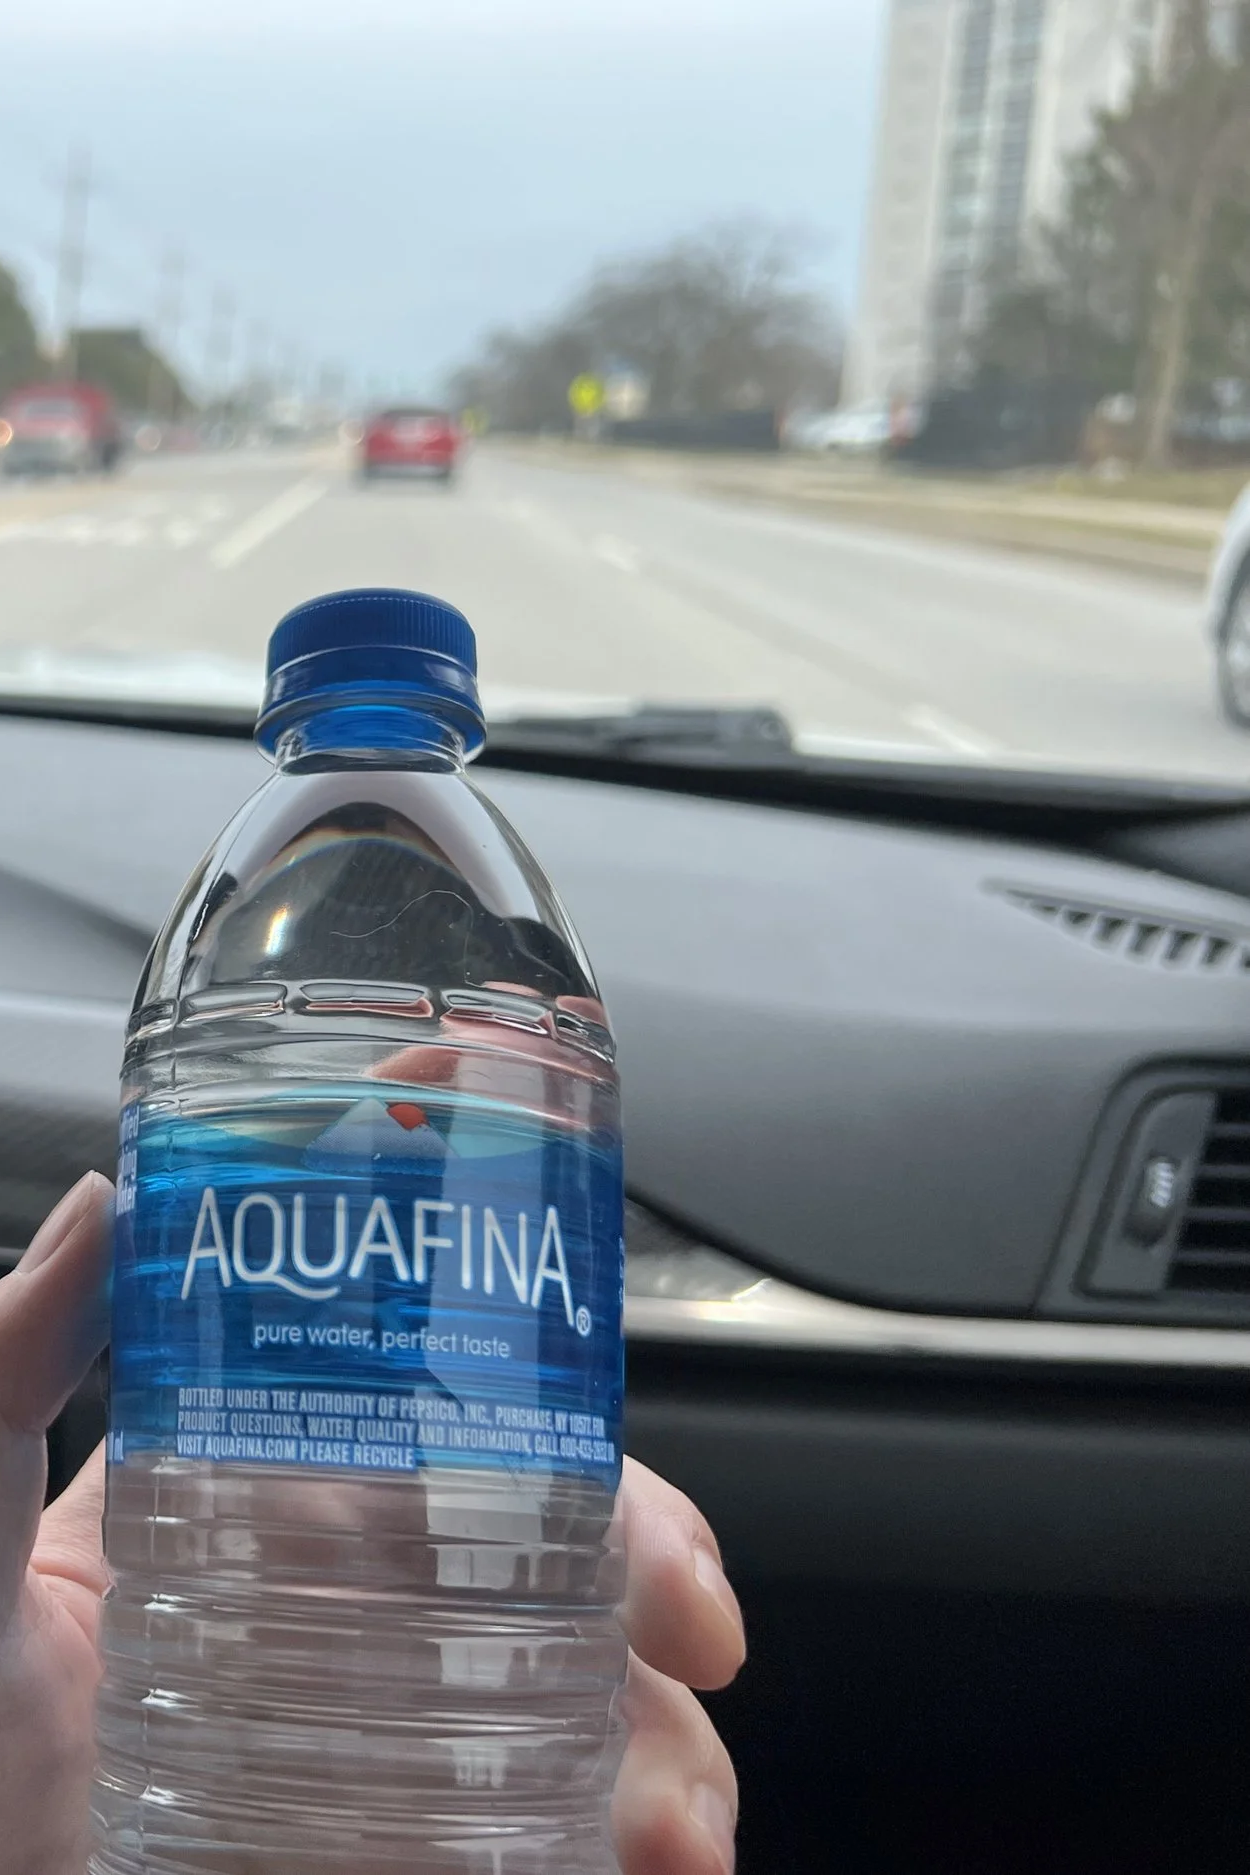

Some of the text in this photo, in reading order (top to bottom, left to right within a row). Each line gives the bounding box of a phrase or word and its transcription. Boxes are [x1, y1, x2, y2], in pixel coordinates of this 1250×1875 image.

[180, 1186, 575, 1328] AQUAFINA
[254, 1323, 511, 1358] pure water, perfect taste
[178, 1387, 225, 1408] BOTTLED
[226, 1389, 268, 1410] UNDER
[270, 1390, 296, 1411] THE
[299, 1391, 375, 1416] AUTHORITY
[377, 1394, 397, 1417] OF
[401, 1397, 461, 1425] PEPSICO,
[554, 1410, 569, 1433] NY
[176, 1434, 416, 1468] VISIT AQUAFINA.COM PLEASE RECYCLE
[177, 1411, 227, 1432] PRODUCT
[230, 1413, 304, 1438] QUESTIONS,
[307, 1416, 353, 1439] WATER
[356, 1419, 417, 1444] QUALITY
[417, 1424, 445, 1446] AND
[448, 1426, 532, 1454] INFORMATION,
[534, 1434, 559, 1456] CALL
